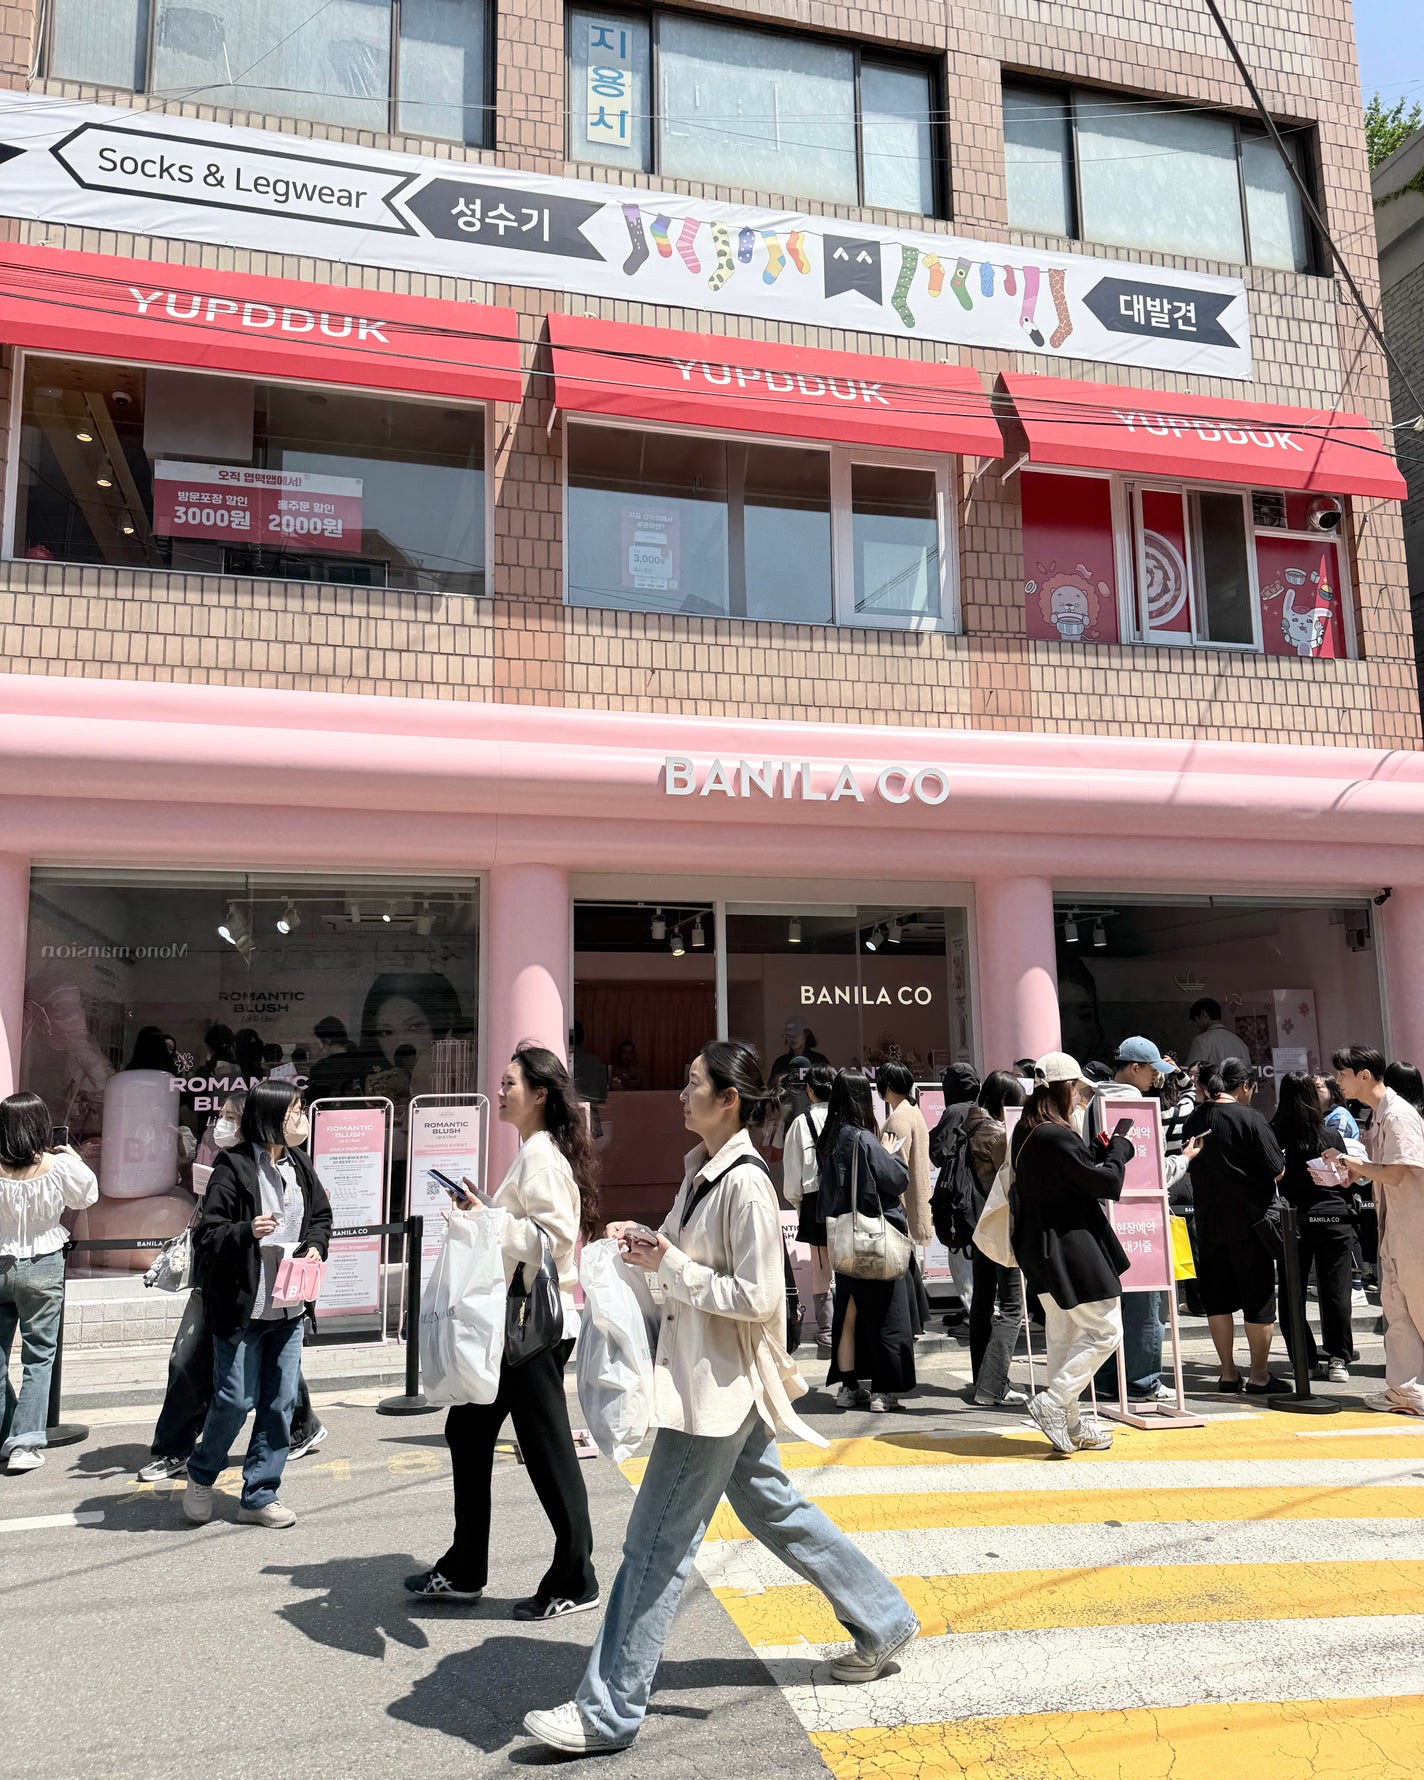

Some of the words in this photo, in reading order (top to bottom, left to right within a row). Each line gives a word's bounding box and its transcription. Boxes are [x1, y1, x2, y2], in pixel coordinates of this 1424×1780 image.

[98, 147, 194, 183] Socks
[202, 163, 226, 188] &
[235, 167, 368, 209] Legwear
[450, 197, 550, 242] 성수기
[128, 288, 391, 343] YUPDDUK
[1119, 294, 1197, 332] 대발견
[669, 356, 891, 404] YUPDDUK
[1111, 410, 1305, 452] YUPDDUK
[218, 470, 240, 482] 오직
[178, 491, 223, 504] 방문포장
[226, 495, 248, 507] 할인
[313, 502, 335, 515] 할인
[173, 506, 251, 530] 3000원
[268, 514, 343, 538] 2000원
[665, 756, 865, 802] BANILA
[876, 766, 951, 805] CO
[218, 991, 305, 1001] ROMANTIC
[800, 985, 892, 1005] BANILA
[898, 985, 932, 1006] CO
[233, 1003, 289, 1013] BLUSH
[326, 1124, 373, 1132] ROMANTIC
[424, 1121, 469, 1129] ROMANTIC
[332, 1229, 357, 1237] BANILA
[1116, 1222, 1156, 1235] 현장예약
